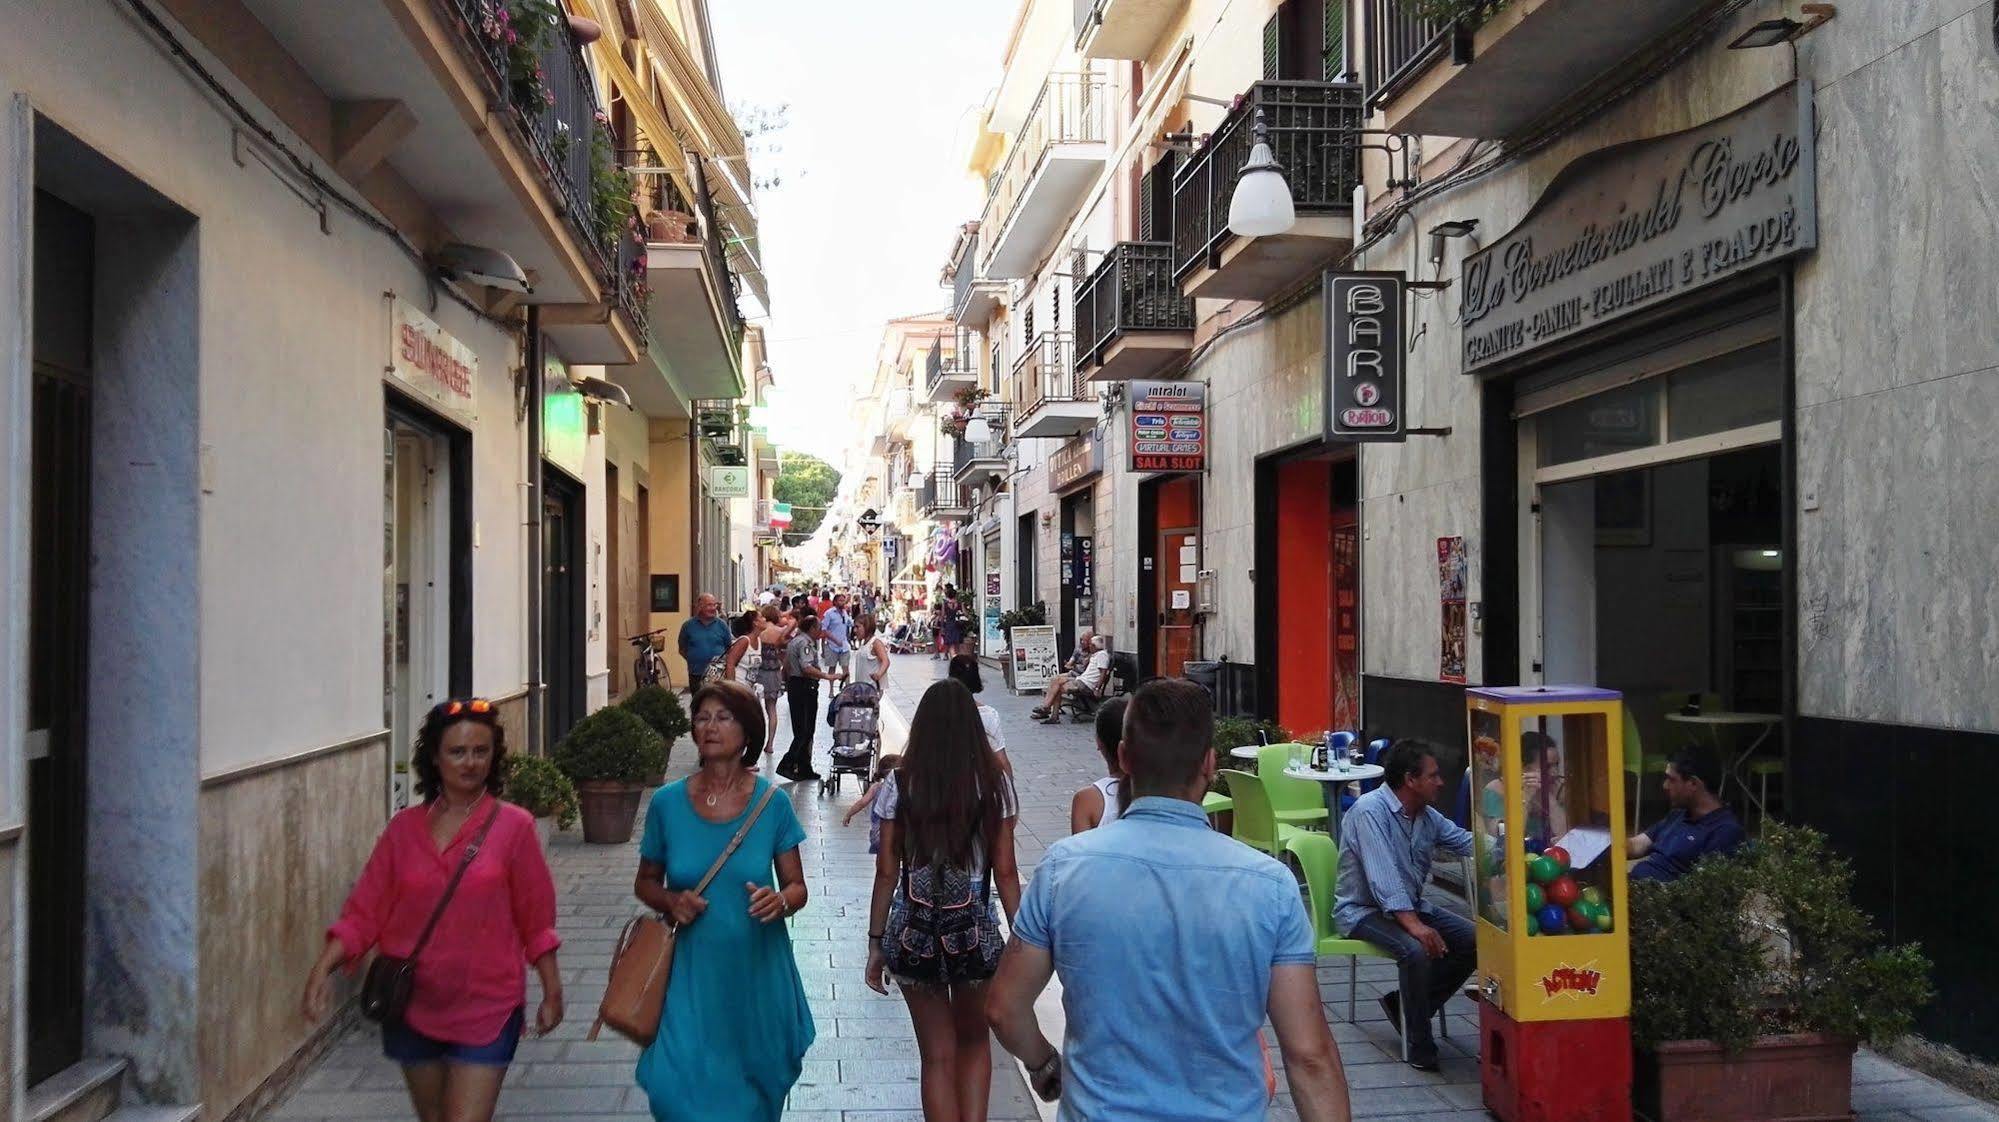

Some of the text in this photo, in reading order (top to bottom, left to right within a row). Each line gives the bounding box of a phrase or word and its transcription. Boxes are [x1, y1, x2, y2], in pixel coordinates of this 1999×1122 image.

[1643, 168, 1687, 242] del
[1689, 133, 1799, 219] Corso
[1347, 284, 1384, 377] BAR
[1136, 457, 1201, 470] SALA SLOT
